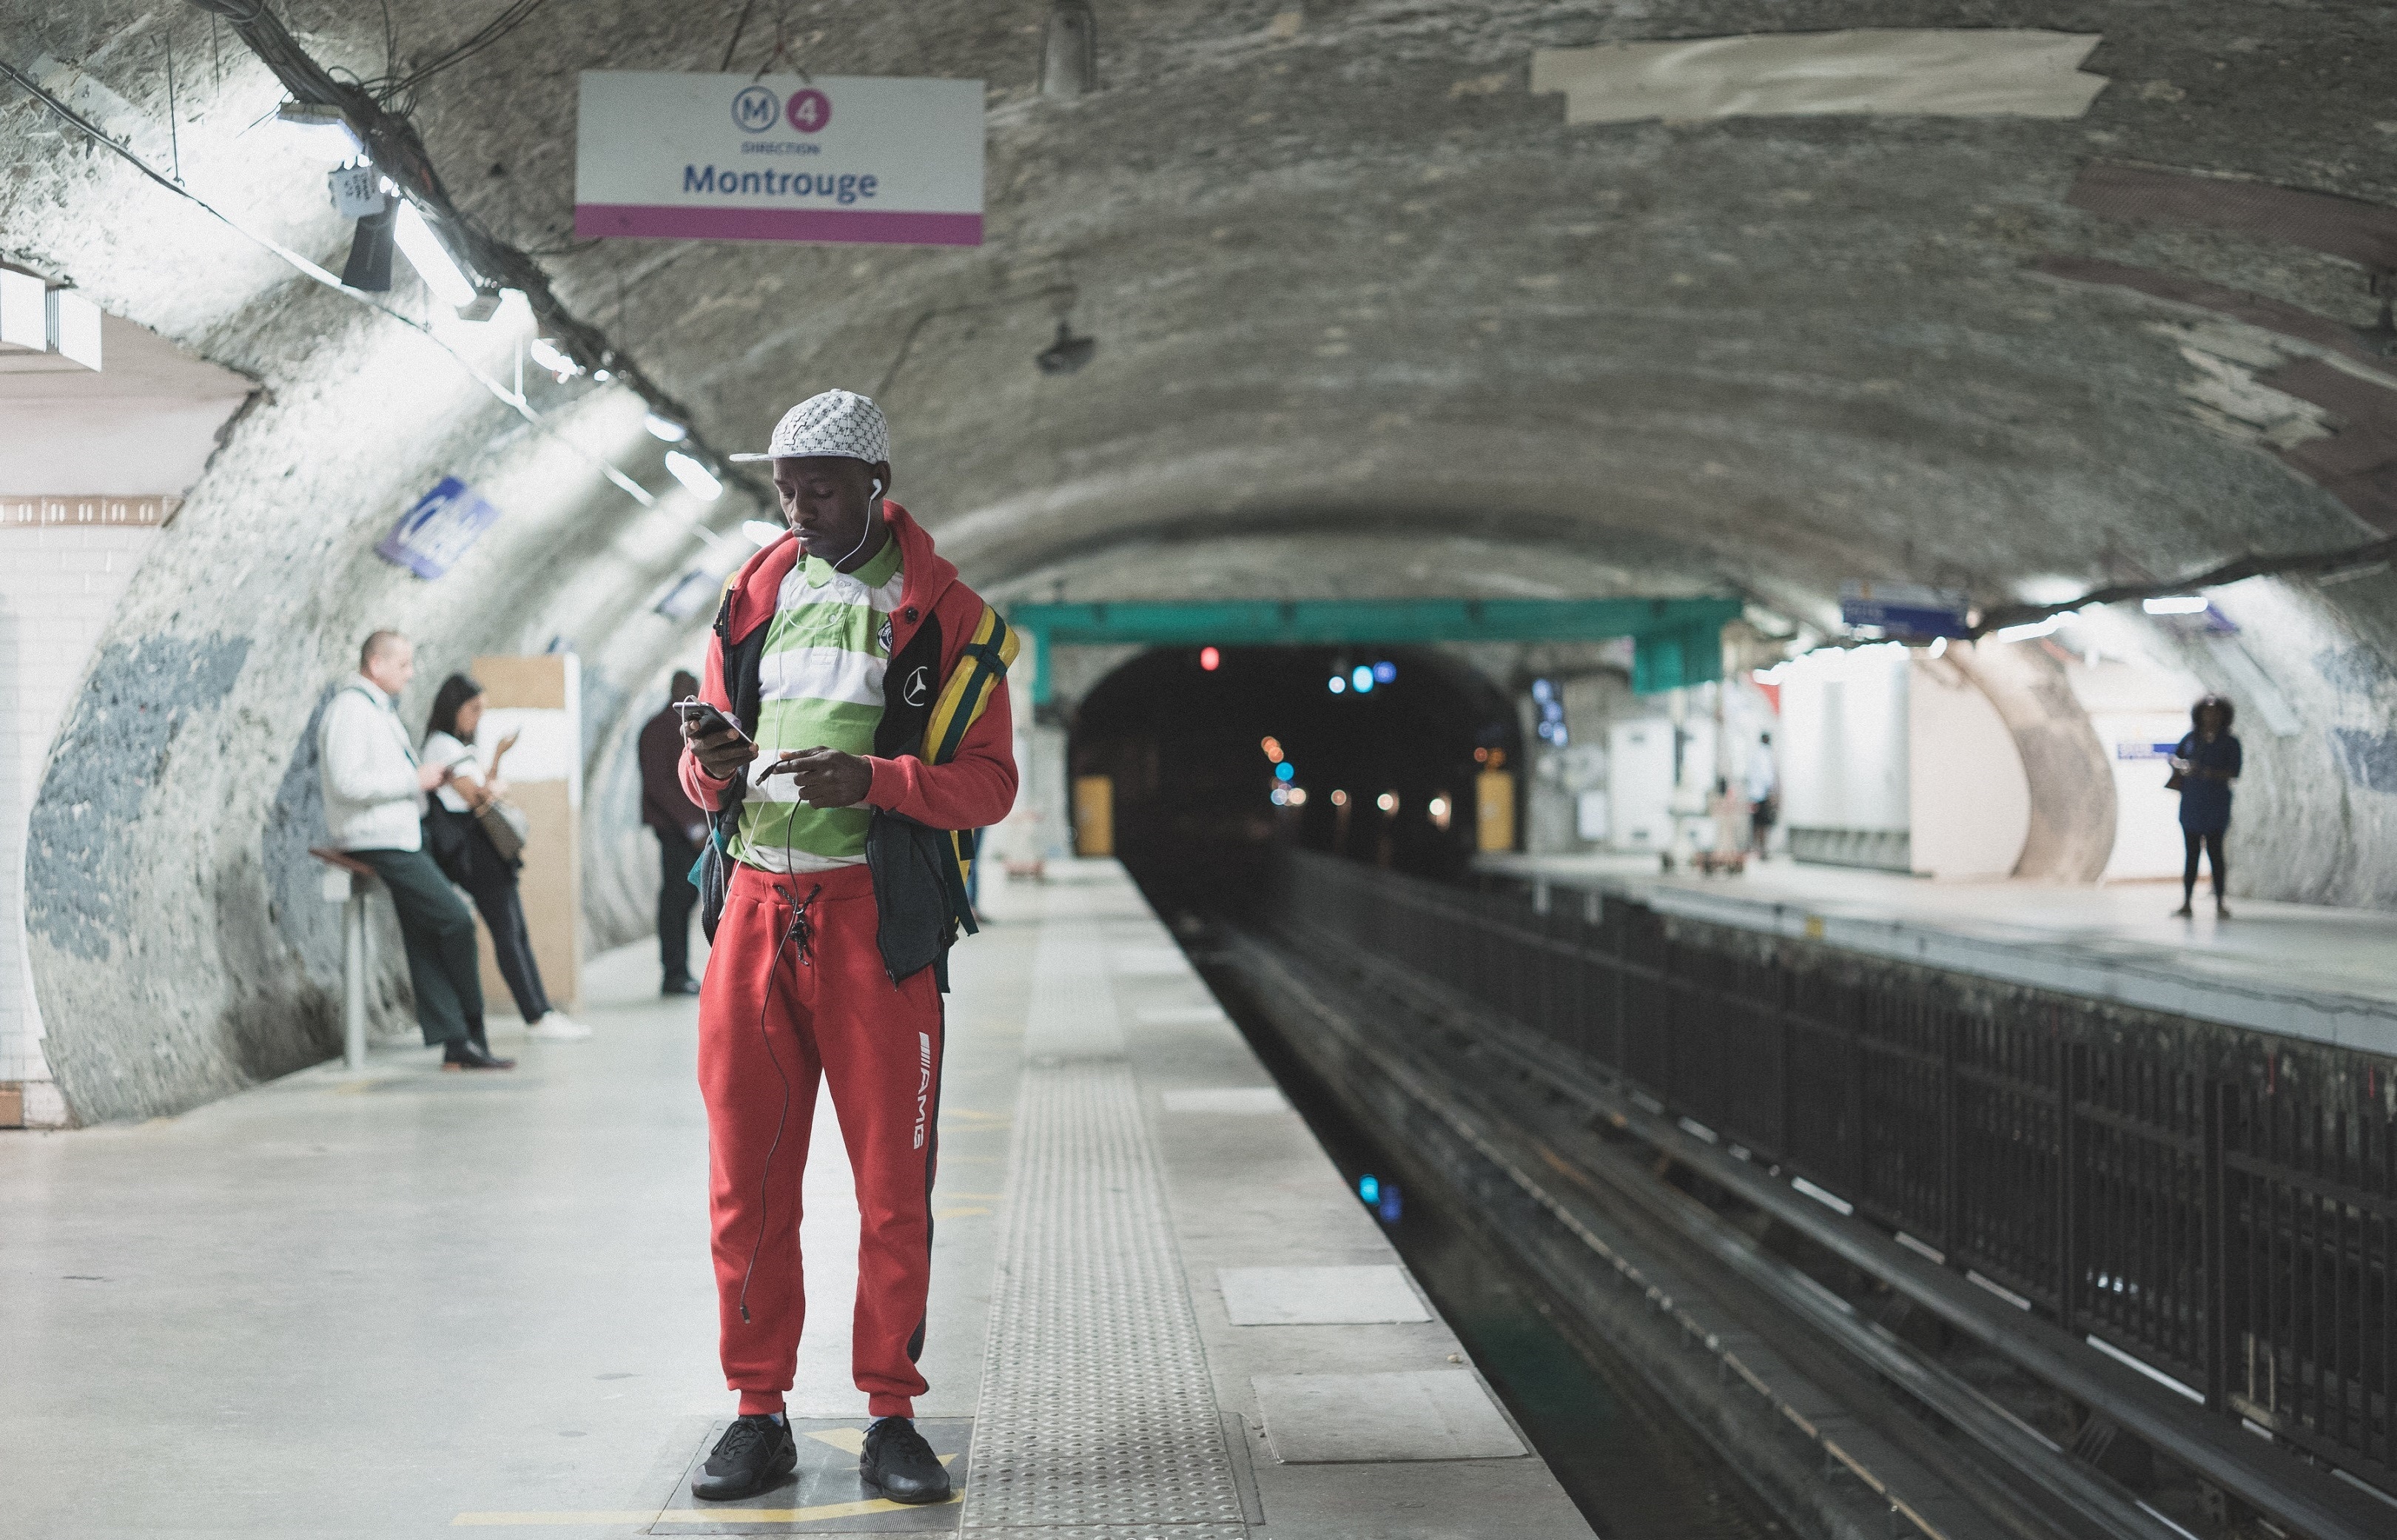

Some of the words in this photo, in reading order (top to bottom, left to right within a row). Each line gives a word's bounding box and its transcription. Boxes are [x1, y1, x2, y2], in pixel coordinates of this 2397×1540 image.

[743, 97, 769, 121] M
[796, 96, 818, 124] 4
[683, 164, 878, 205] Montrouge
[914, 1067, 930, 1149] AMG
